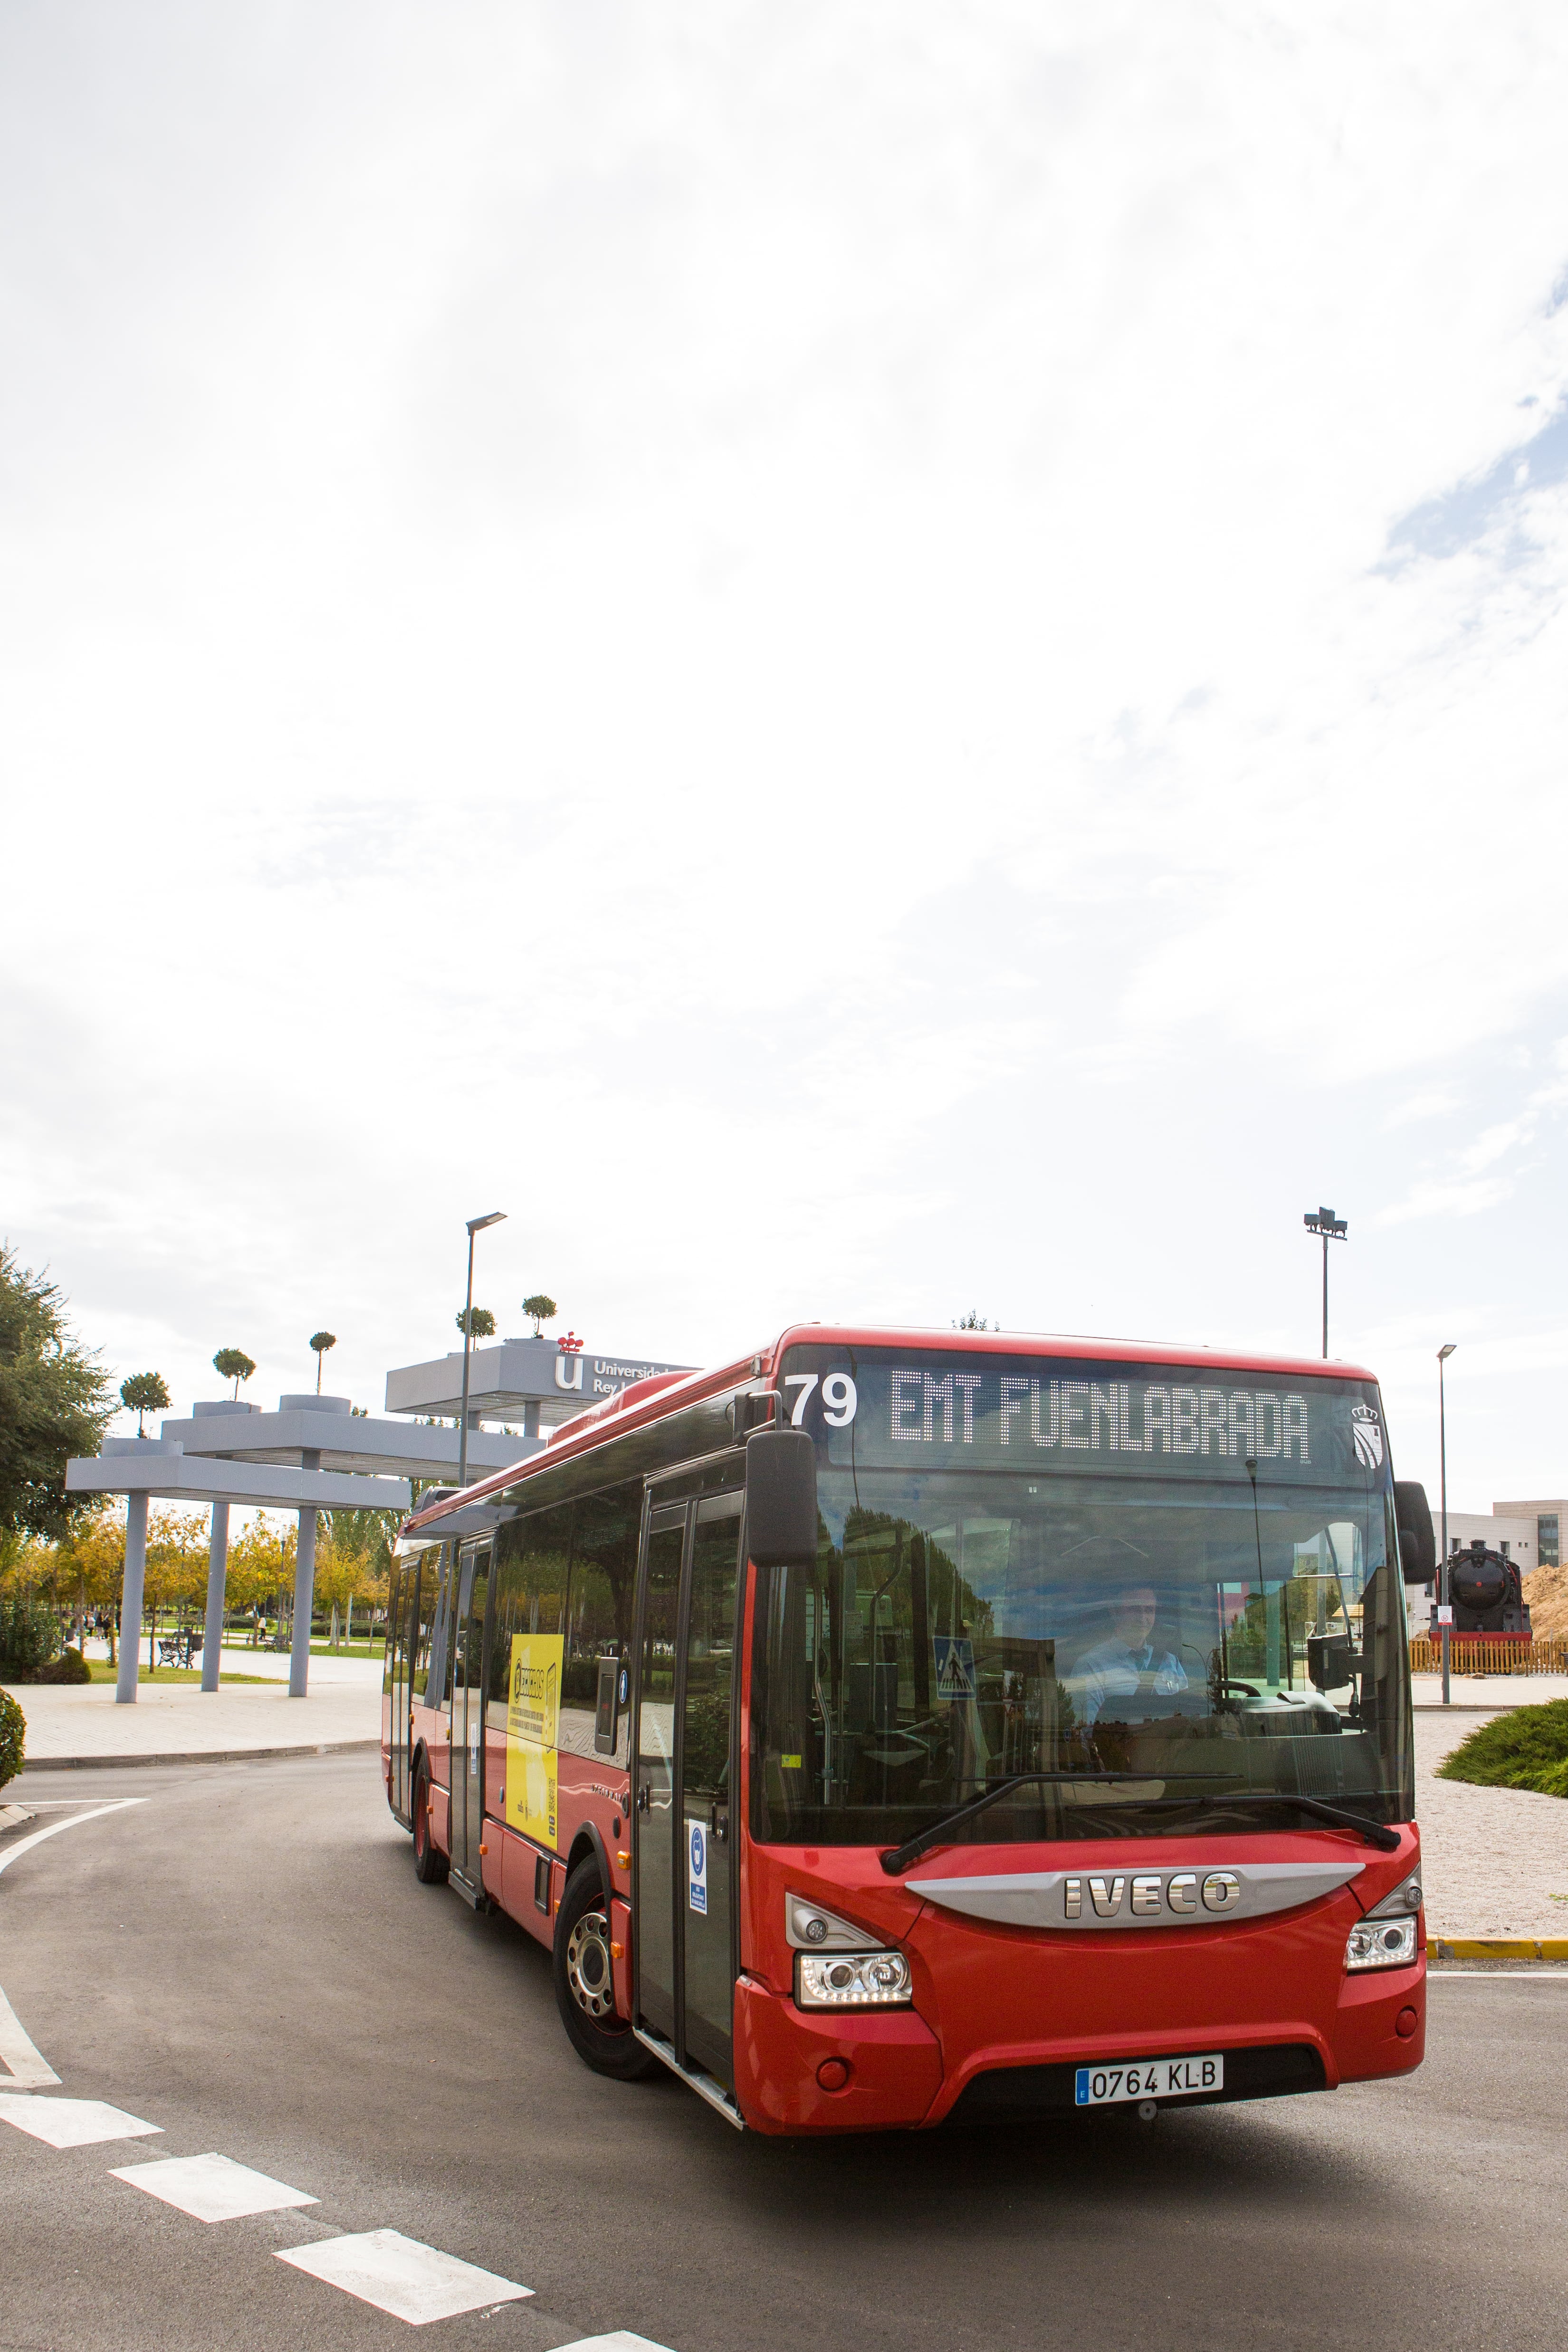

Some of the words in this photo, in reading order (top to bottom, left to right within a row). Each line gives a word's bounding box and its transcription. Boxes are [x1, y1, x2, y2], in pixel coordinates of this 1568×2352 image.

[593, 1379, 618, 1397] Rey
[784, 1372, 857, 1427] 79
[891, 1370, 981, 1443] EMT
[1000, 1377, 1308, 1459] FUENLABRADA
[1064, 1872, 1240, 1919] IVECO
[1080, 2090, 1085, 2098] E
[1093, 2067, 1158, 2098] 0764
[1169, 2061, 1215, 2090] KLB
